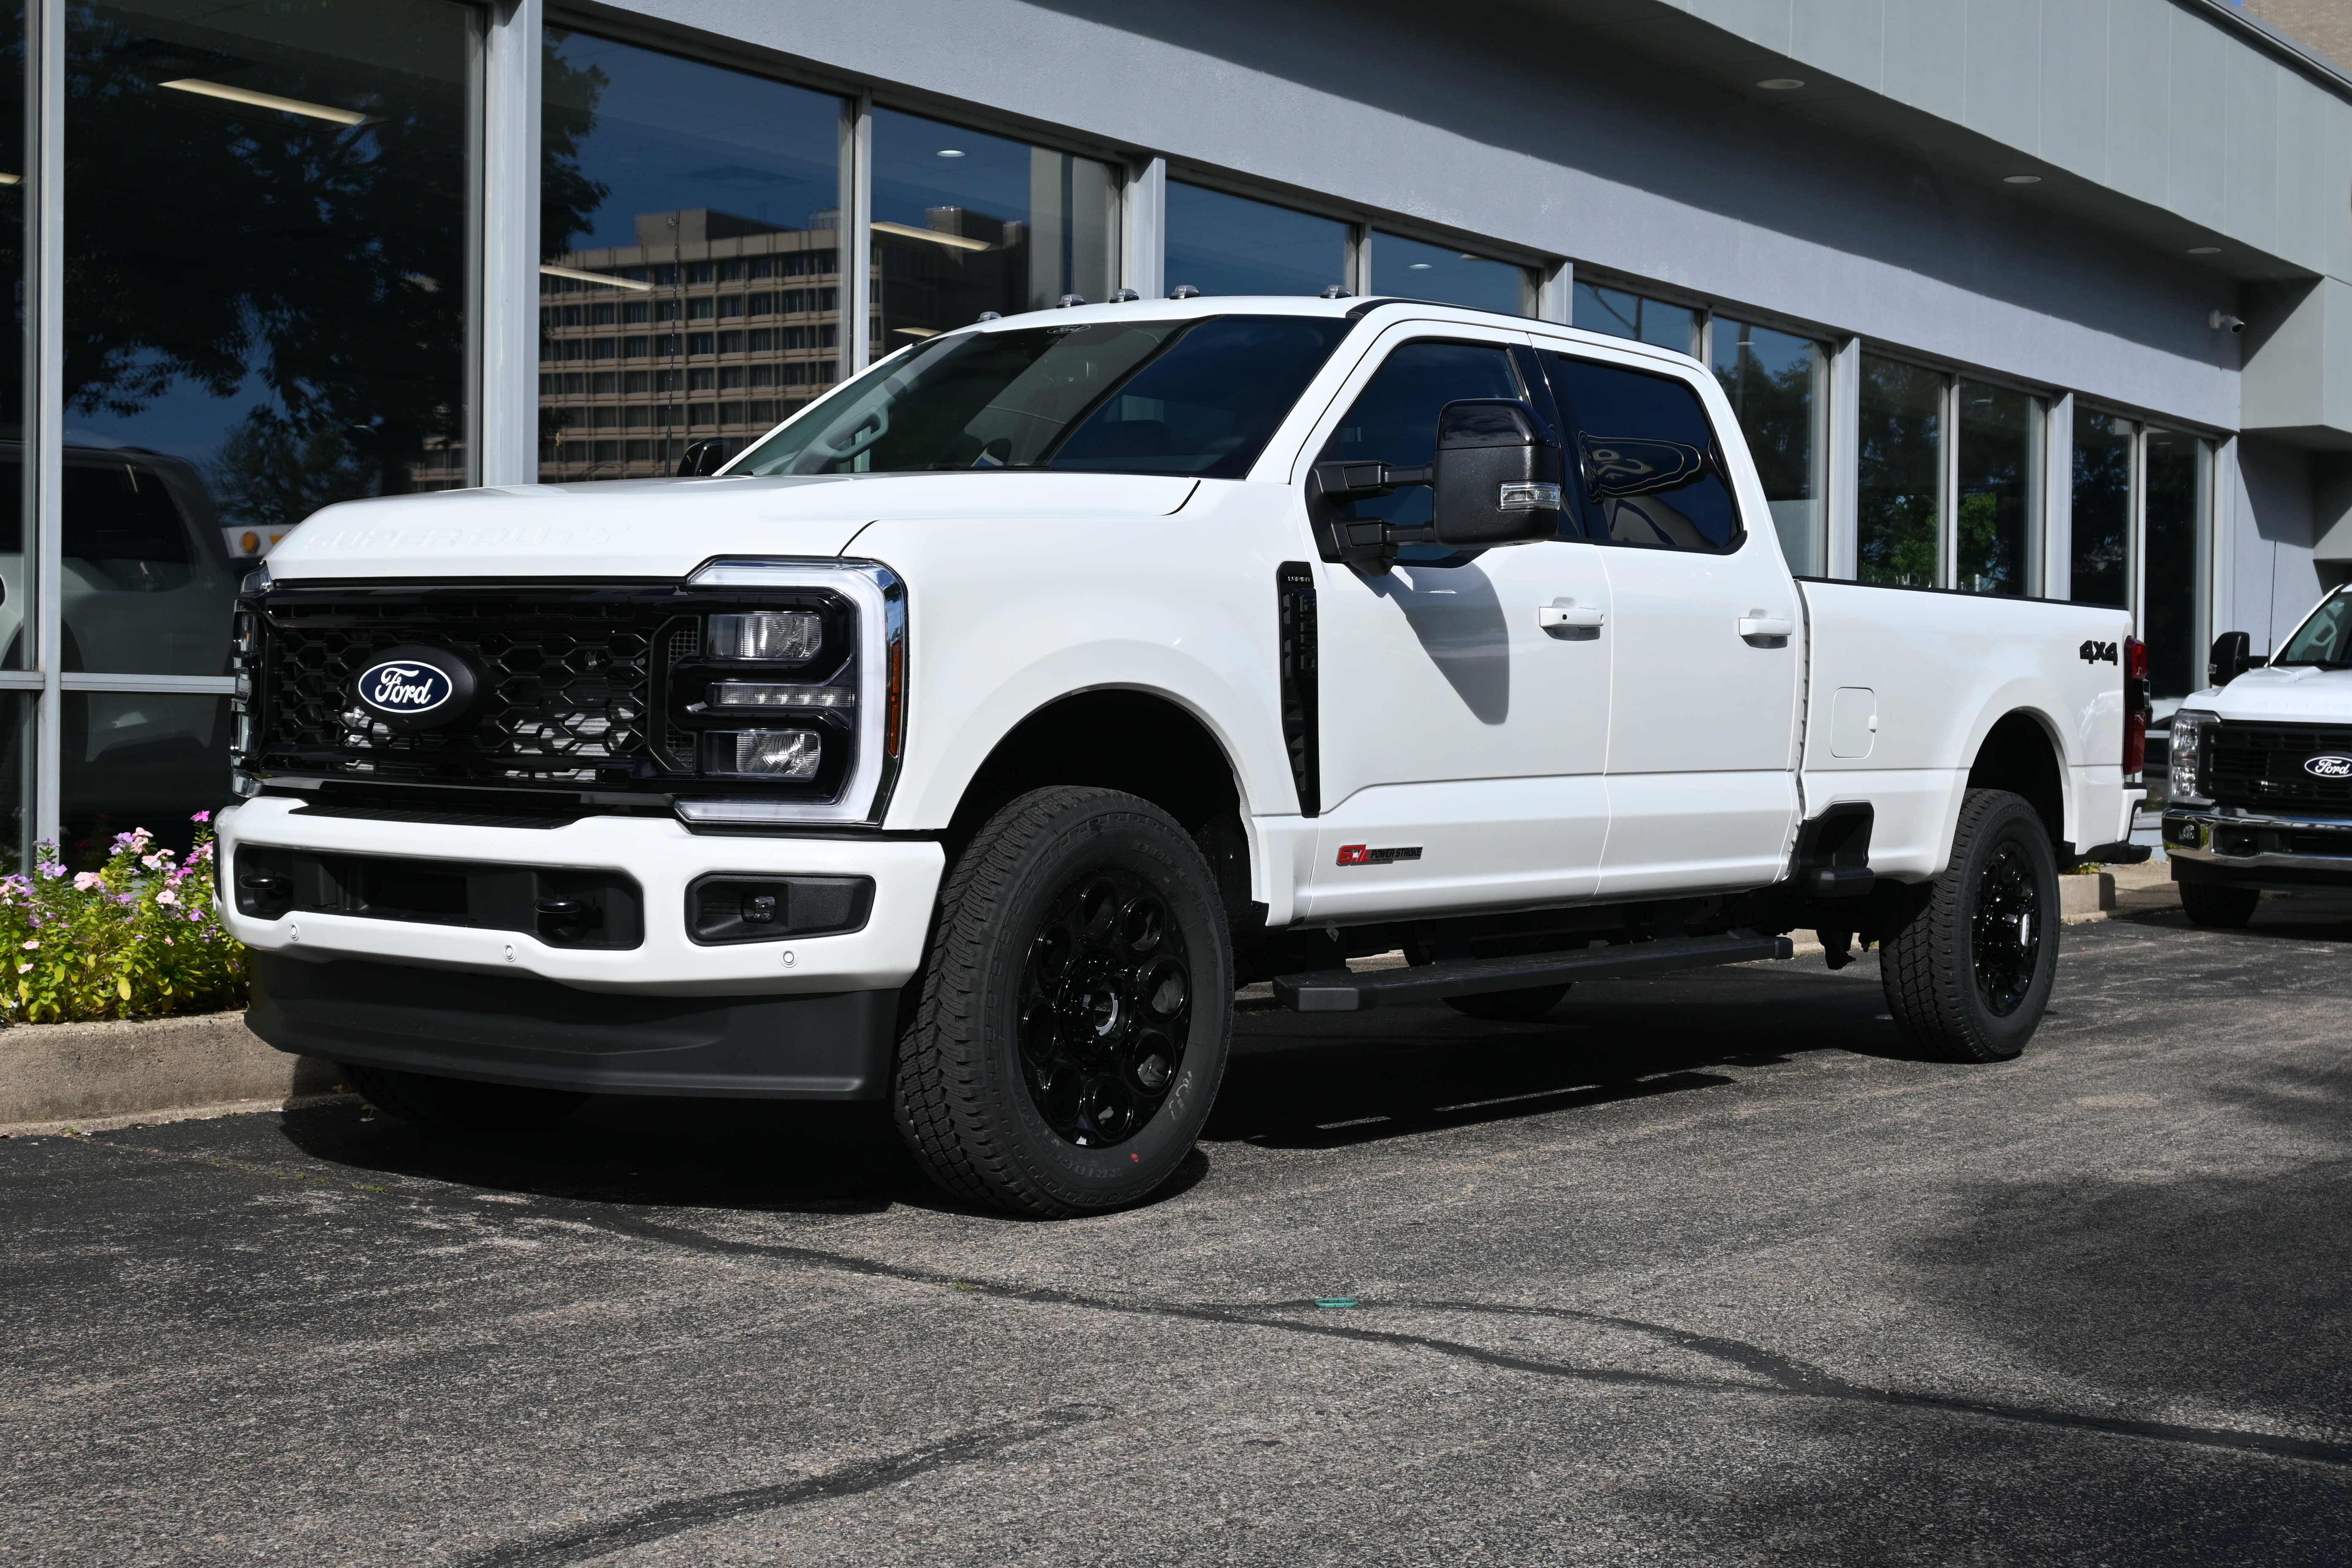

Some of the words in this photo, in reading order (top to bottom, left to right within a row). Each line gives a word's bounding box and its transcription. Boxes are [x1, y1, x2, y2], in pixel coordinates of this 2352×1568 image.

[305, 528, 463, 550] SUPER
[466, 525, 630, 546] DUTY
[375, 667, 433, 704] Ford
[2315, 759, 2350, 775] Ford
[1337, 844, 1370, 863] 6.7L
[1371, 848, 1394, 859] POWER
[1395, 847, 1422, 858] STROKE
[1130, 839, 1211, 923] DUELER
